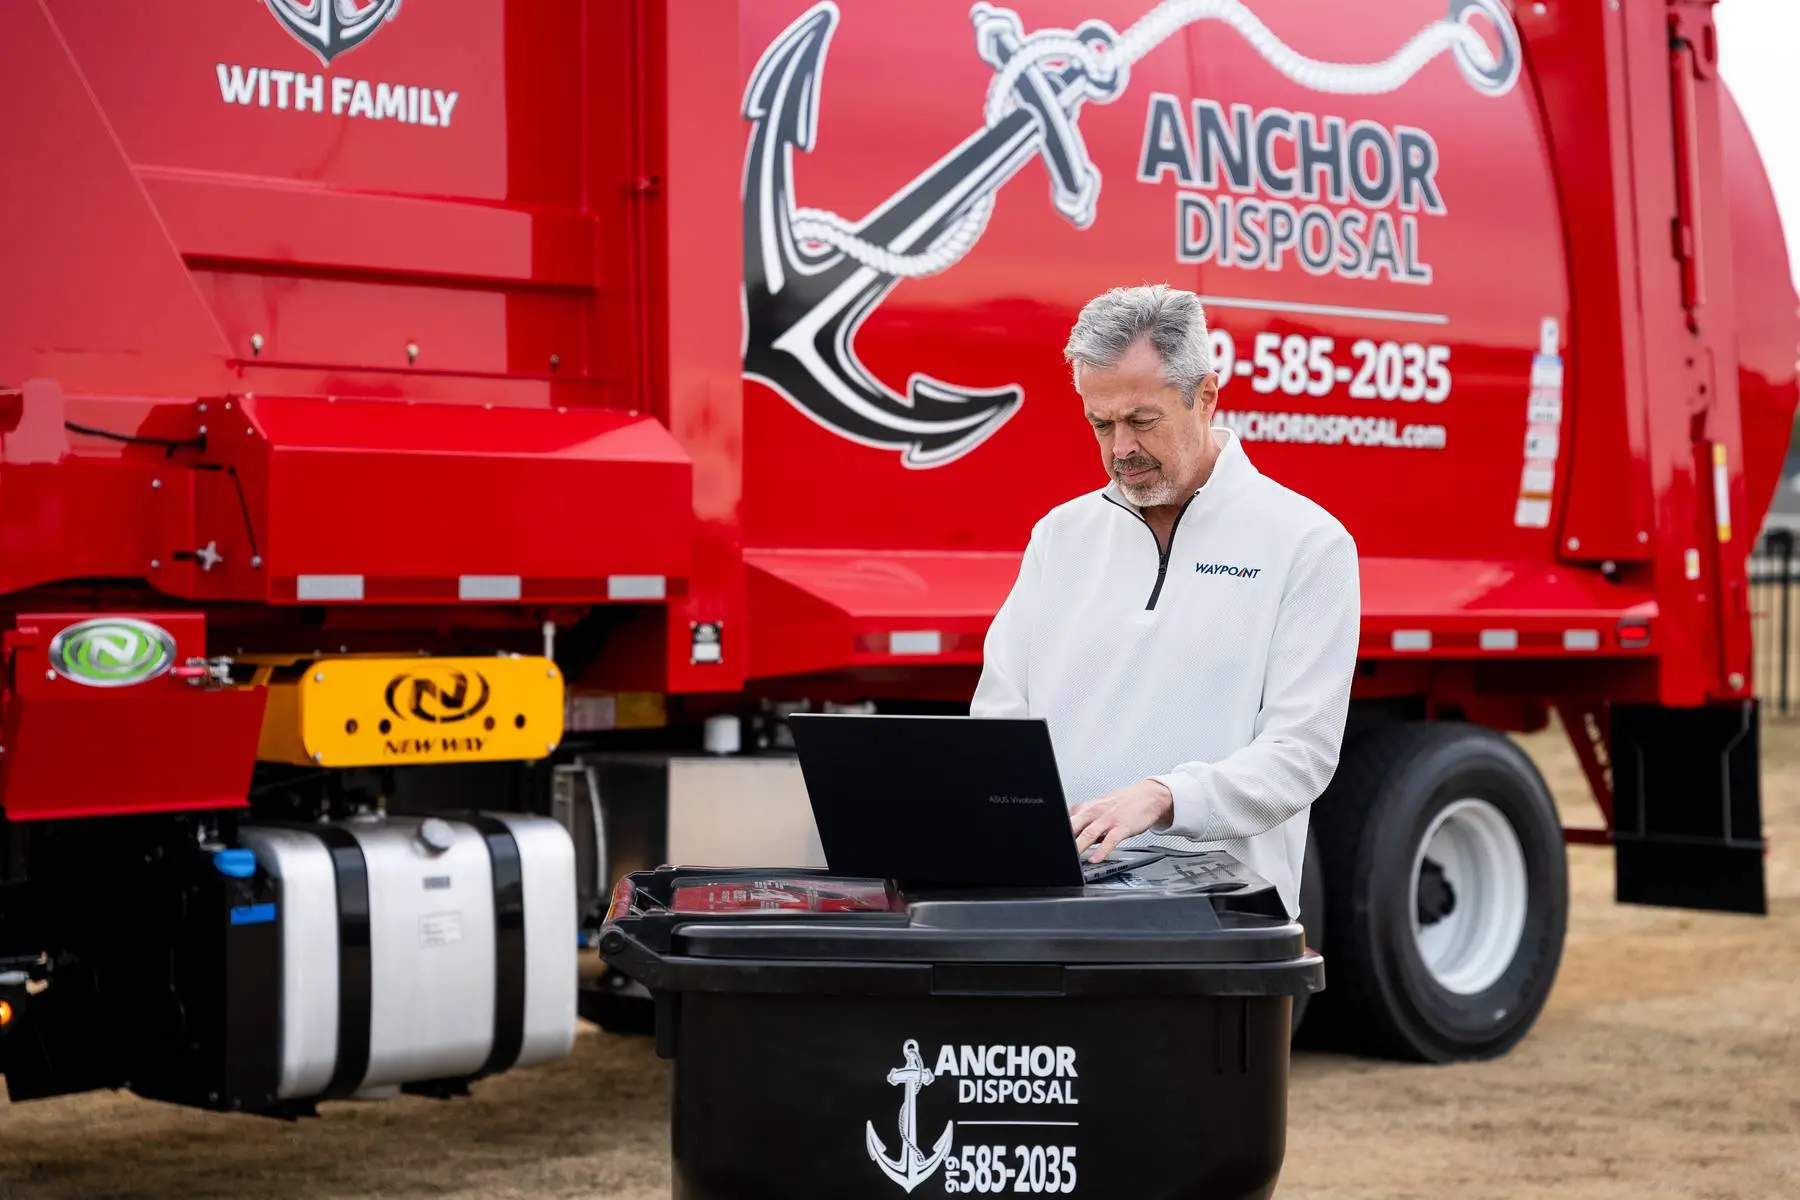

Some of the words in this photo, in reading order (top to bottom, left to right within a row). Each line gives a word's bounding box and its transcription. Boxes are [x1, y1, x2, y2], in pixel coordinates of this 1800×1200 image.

[216, 63, 324, 113] WITH
[331, 76, 459, 128] FAMILY
[1138, 92, 1447, 214] ANCHOR
[1175, 191, 1433, 285] DISPOSAL
[1195, 561, 1262, 579] WAYPOINT
[383, 738, 436, 755] NEW
[442, 737, 488, 752] WAY
[988, 795, 1009, 804] ASUS
[934, 1045, 1079, 1078] ANCHOR
[958, 1079, 1080, 1105] DISPOSAL
[960, 1144, 1077, 1194] 585-2035
